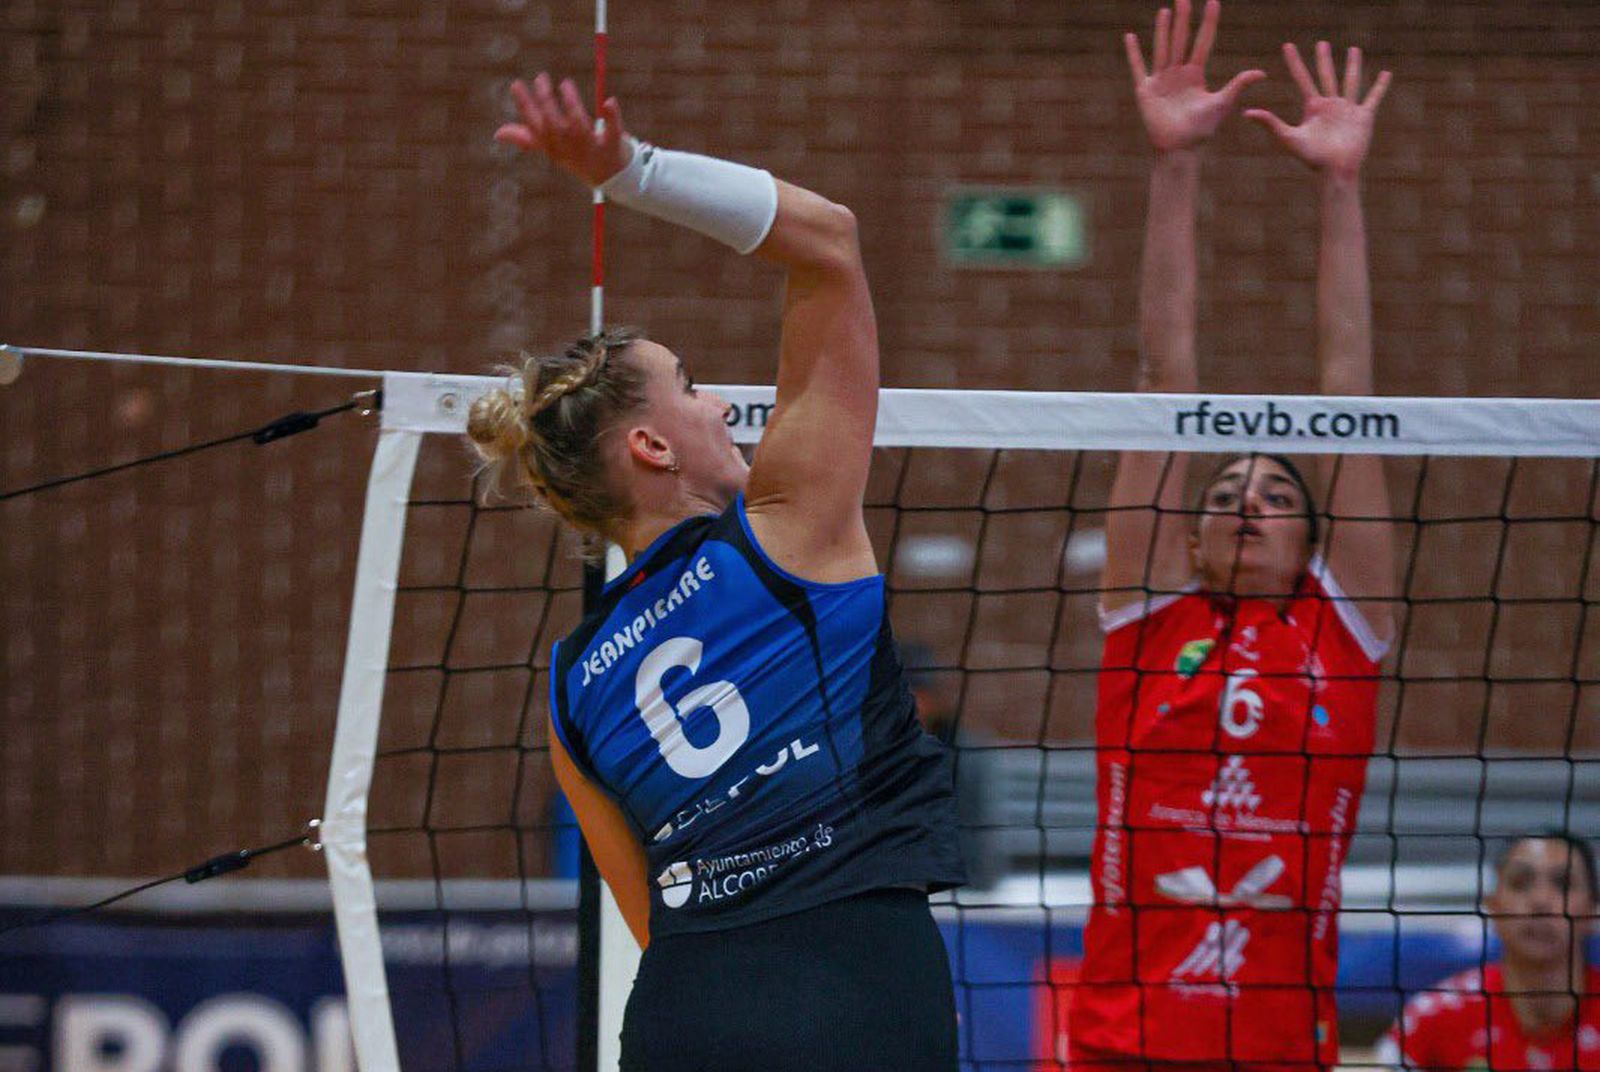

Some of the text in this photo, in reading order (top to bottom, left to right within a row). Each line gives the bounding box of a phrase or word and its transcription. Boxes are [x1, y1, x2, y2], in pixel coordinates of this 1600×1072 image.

[1175, 401, 1400, 438] rfevb.com
[582, 556, 715, 687] JEANPIERRE
[635, 636, 751, 779] 6
[1219, 668, 1264, 738] 6
